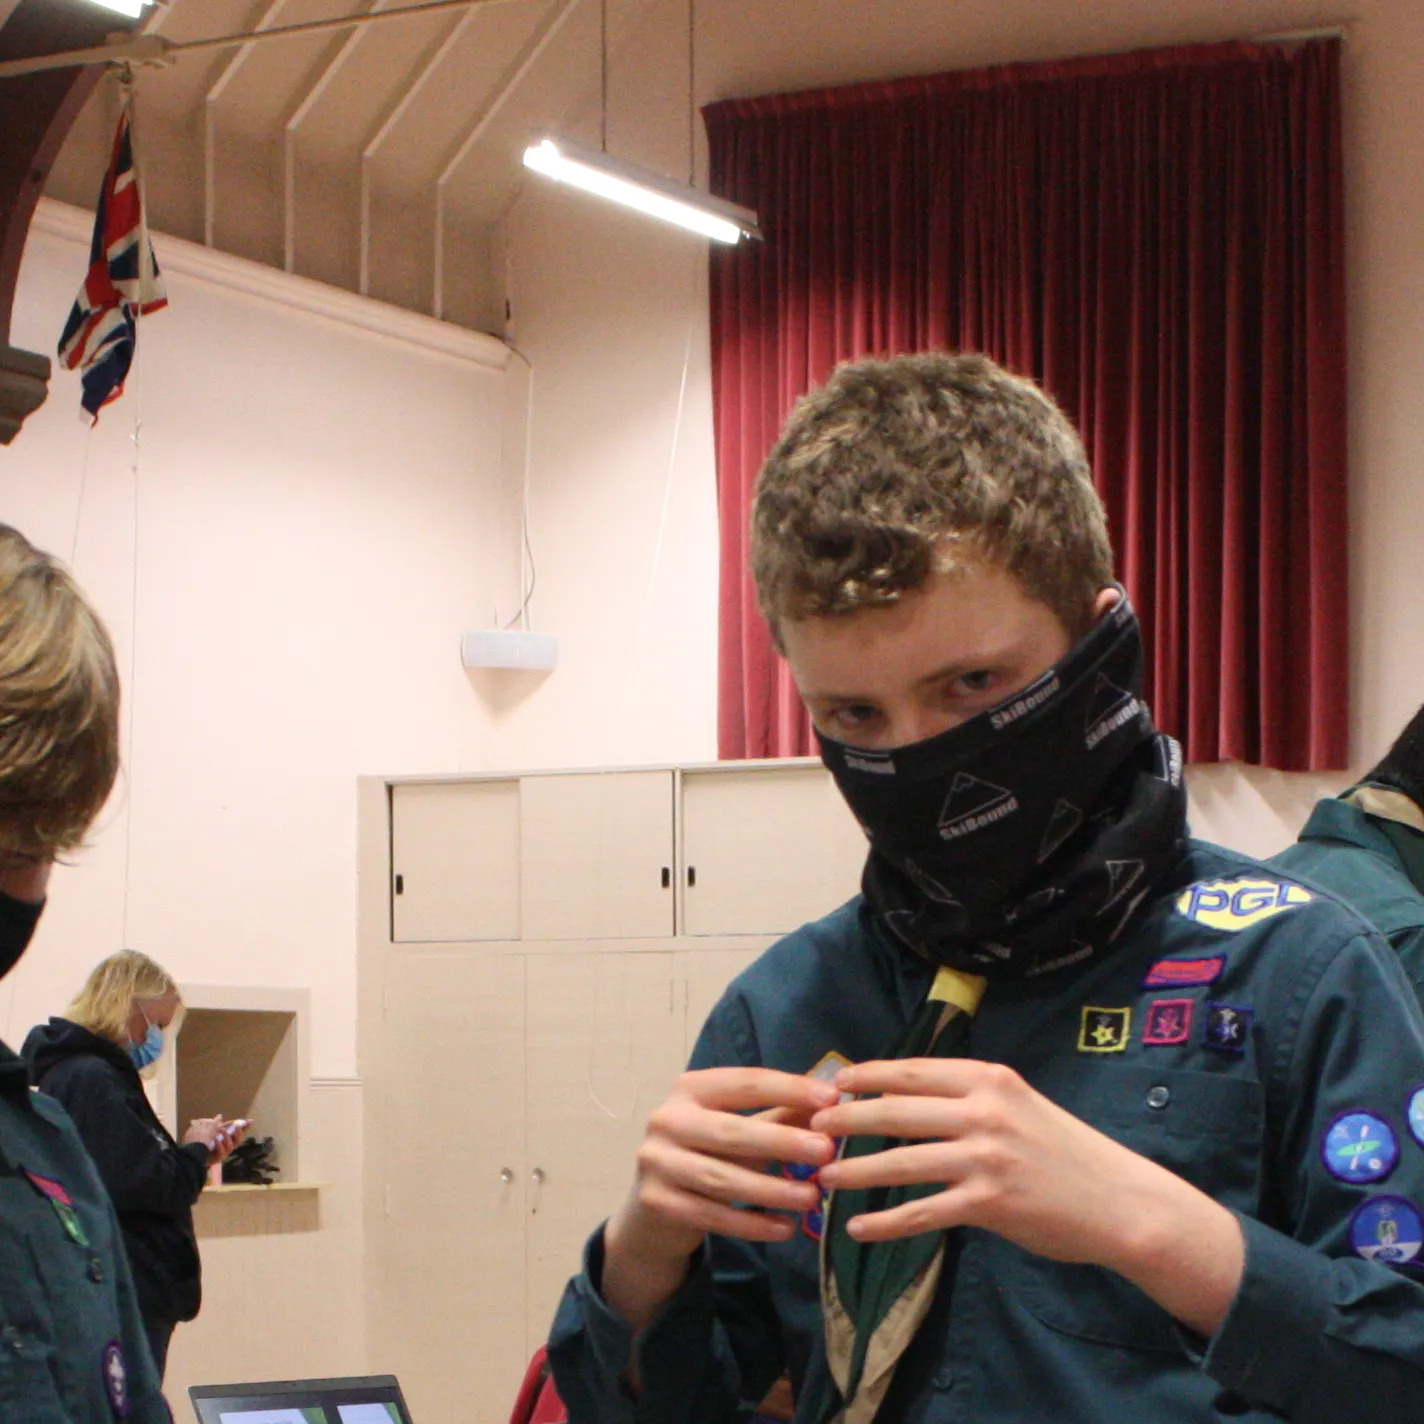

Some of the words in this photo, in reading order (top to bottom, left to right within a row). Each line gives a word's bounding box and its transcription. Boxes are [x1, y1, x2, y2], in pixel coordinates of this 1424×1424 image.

[990, 677, 1060, 731] SkiBound
[939, 796, 1018, 841] SkiBound
[1187, 882, 1310, 921] PGL
